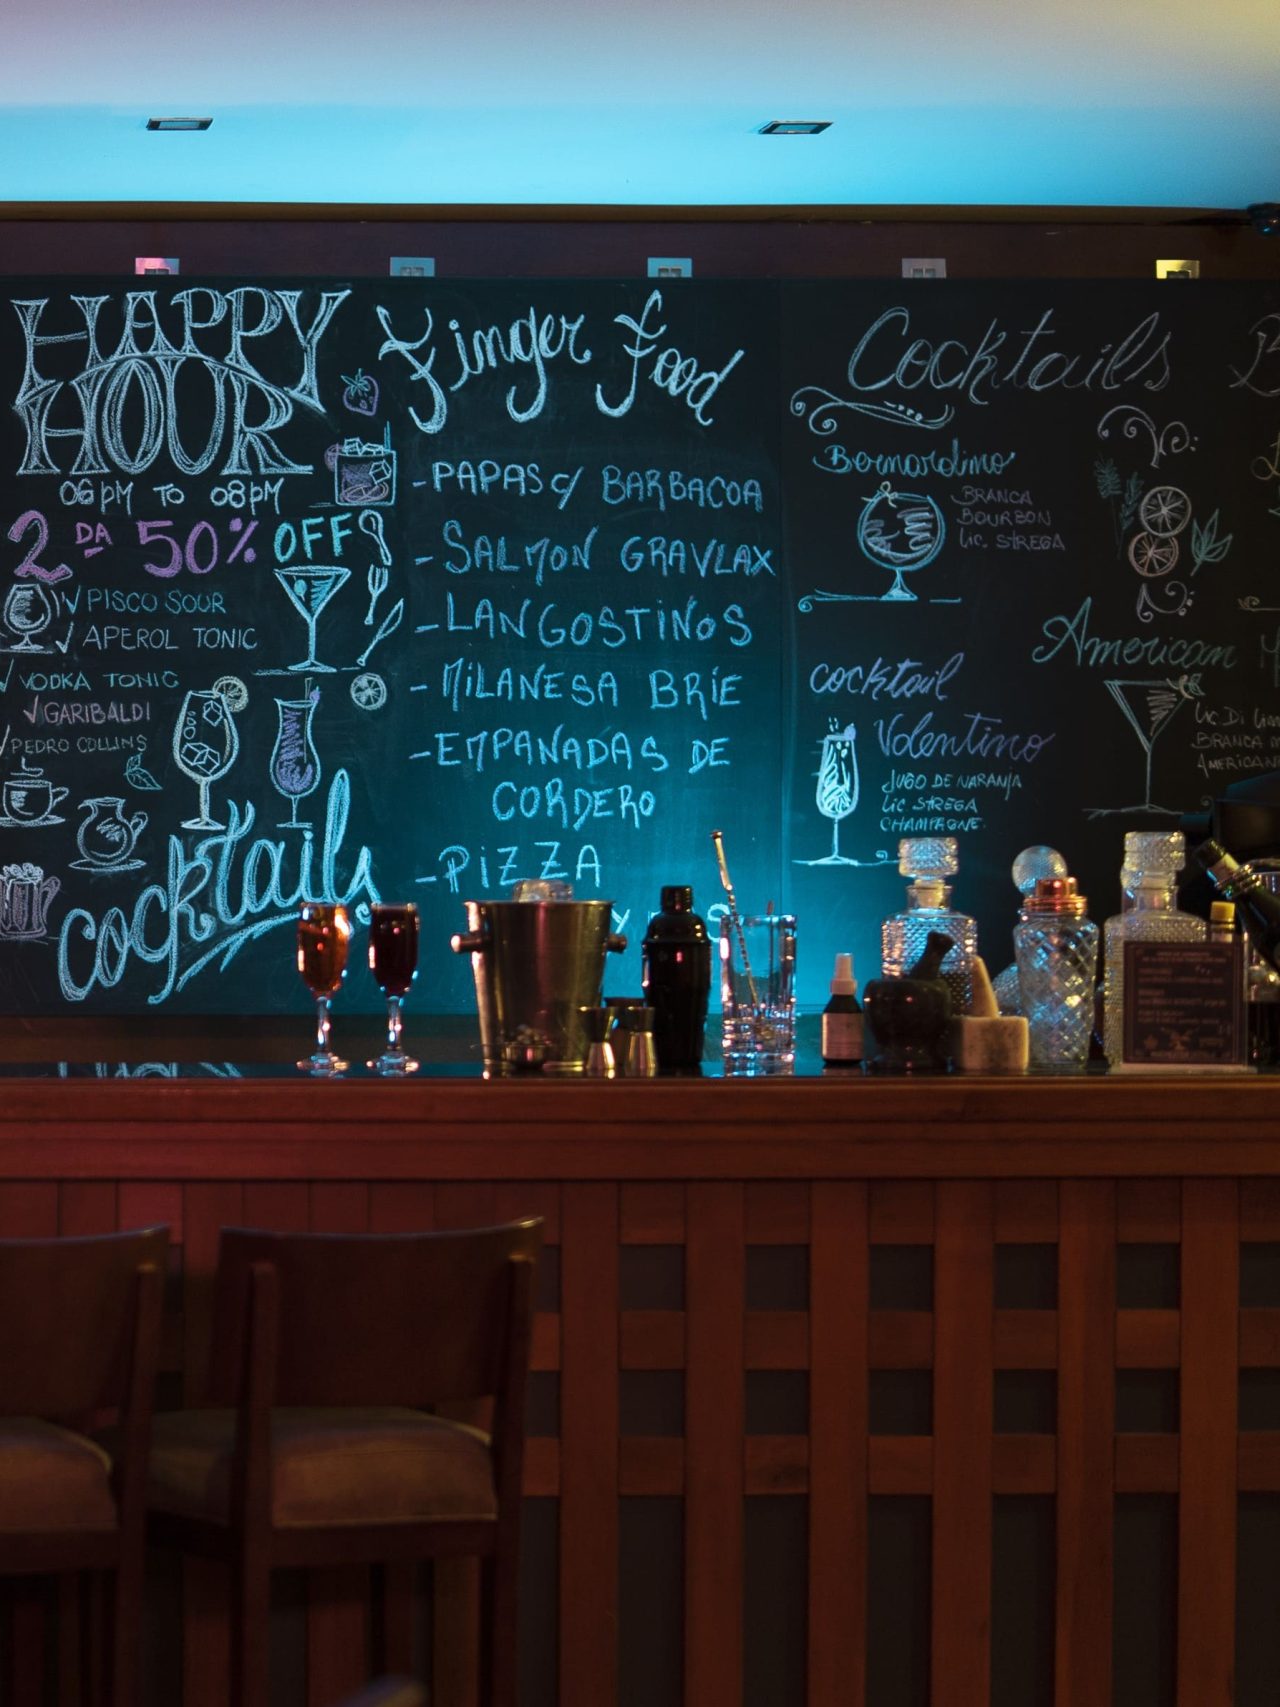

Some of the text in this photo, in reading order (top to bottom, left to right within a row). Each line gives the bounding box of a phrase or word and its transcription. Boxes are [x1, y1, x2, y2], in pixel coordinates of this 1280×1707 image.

[10, 287, 353, 413] HAPPY
[377, 289, 745, 434] Finger Food
[847, 306, 1170, 405] Cocktails
[13, 352, 314, 476] HOUR
[601, 464, 763, 512] BARBACOA
[950, 485, 1033, 506] BRANCA
[957, 507, 1052, 527] BOURBON
[8, 510, 73, 585] 2
[136, 517, 259, 579] 50%
[274, 512, 353, 564] OFF
[620, 535, 777, 578] GRAVLAX
[87, 586, 228, 616] PISCO SOUR
[83, 625, 258, 651] APEROL TONIC
[19, 671, 180, 692] VODKA TONIC
[649, 665, 742, 720] BRIE
[44, 702, 151, 725] GARIBALDI
[10, 734, 148, 753] PEDRO COLLINS
[688, 736, 731, 774] DE
[1189, 731, 1263, 750] BRANCA
[492, 777, 656, 830] CORDERO
[881, 768, 1022, 801] JUGO DE NARANJA
